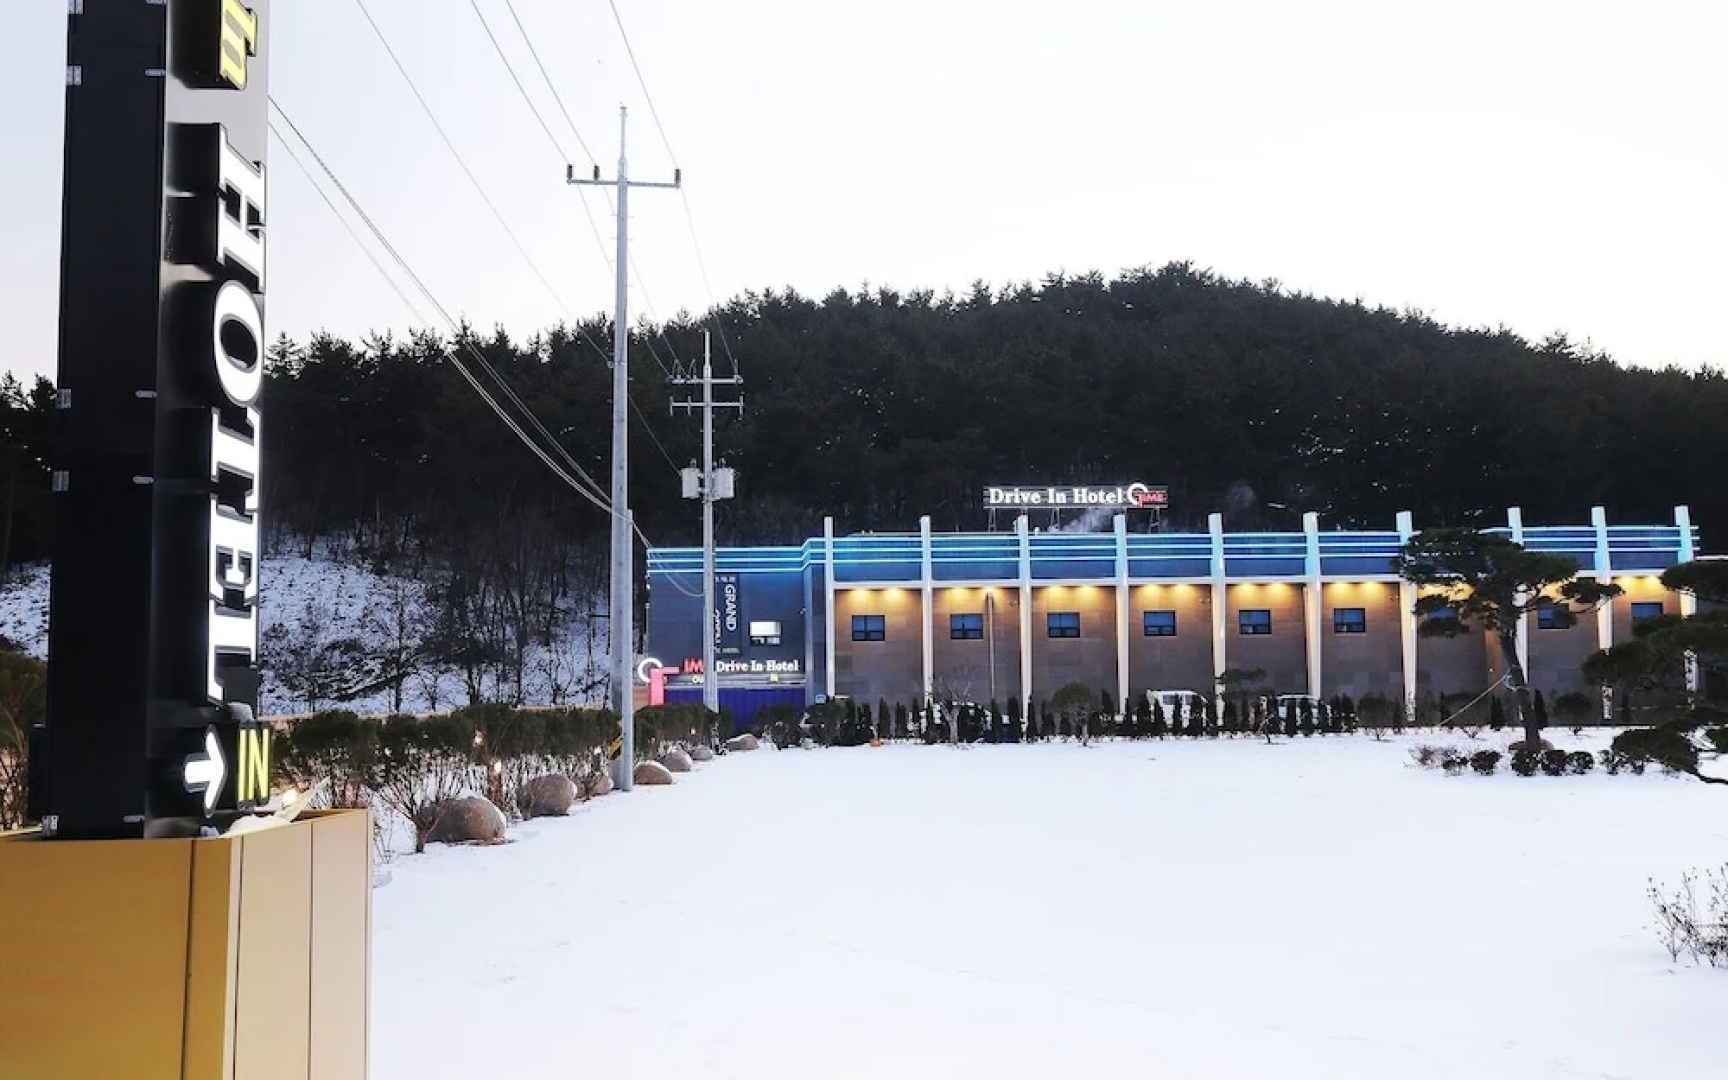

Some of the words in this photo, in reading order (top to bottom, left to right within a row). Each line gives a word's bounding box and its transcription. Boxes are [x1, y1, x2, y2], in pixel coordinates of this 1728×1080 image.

[207, 124, 267, 703] HOTEL
[989, 487, 1041, 504] Drive
[1049, 488, 1067, 504] In
[1073, 487, 1123, 504] Hotel
[725, 584, 737, 631] GRAND
[716, 660, 748, 672] Drive
[751, 660, 763, 671] In
[766, 660, 799, 671] Hotel
[239, 728, 269, 801] IN
